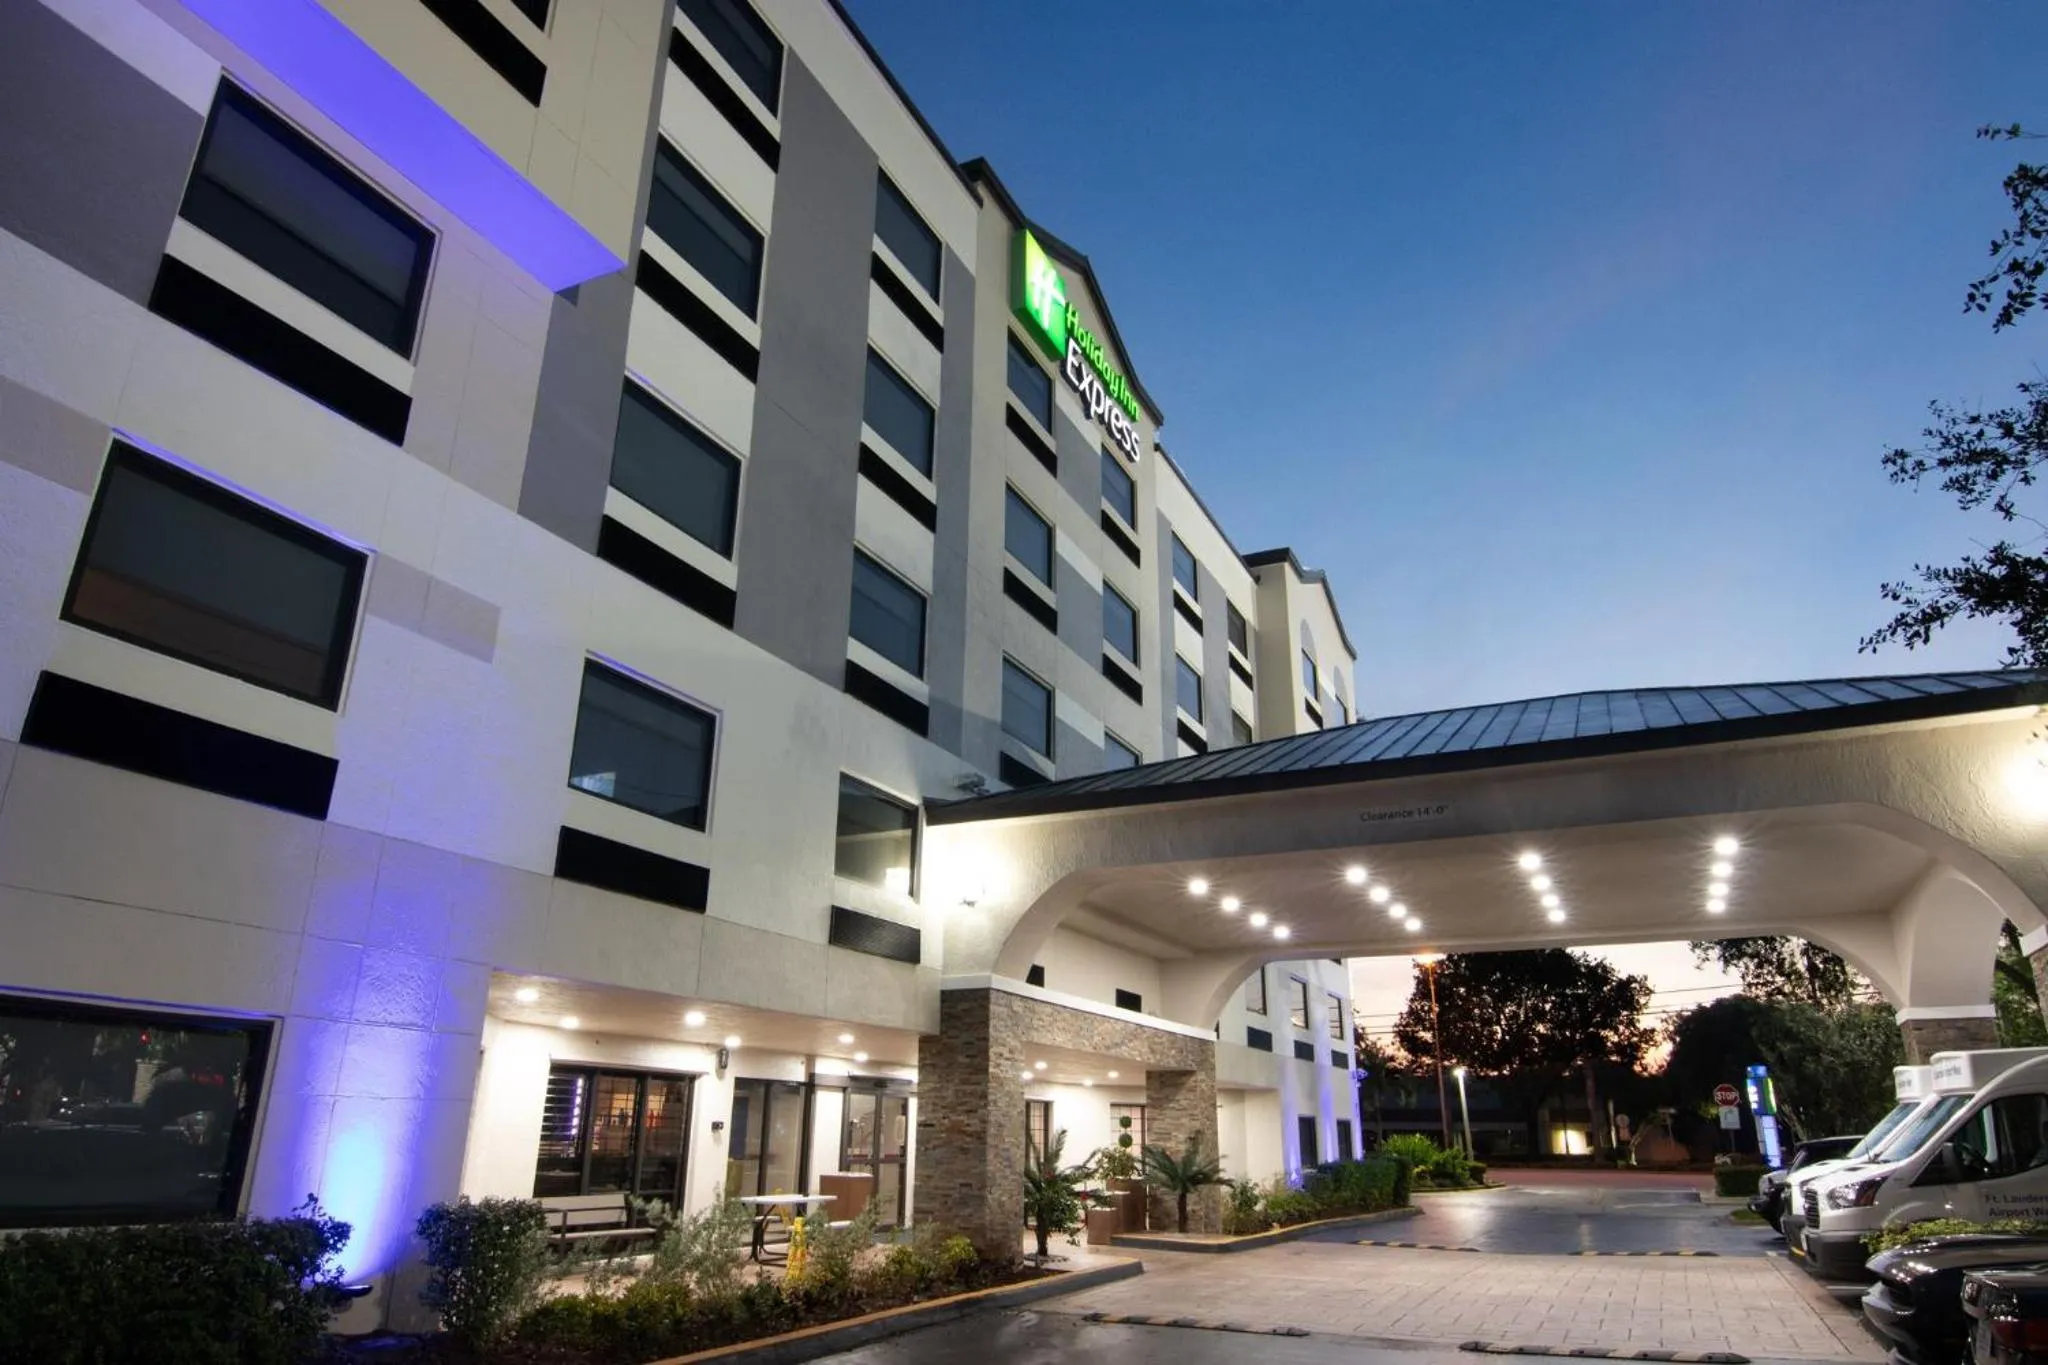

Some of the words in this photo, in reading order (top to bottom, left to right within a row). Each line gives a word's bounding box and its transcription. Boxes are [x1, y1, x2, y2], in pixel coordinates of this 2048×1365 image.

[1066, 337, 1141, 462] Express
[1359, 809, 1414, 822] Clearance
[1714, 1090, 1737, 1101] STOP
[1988, 1206, 2029, 1218] Airport
